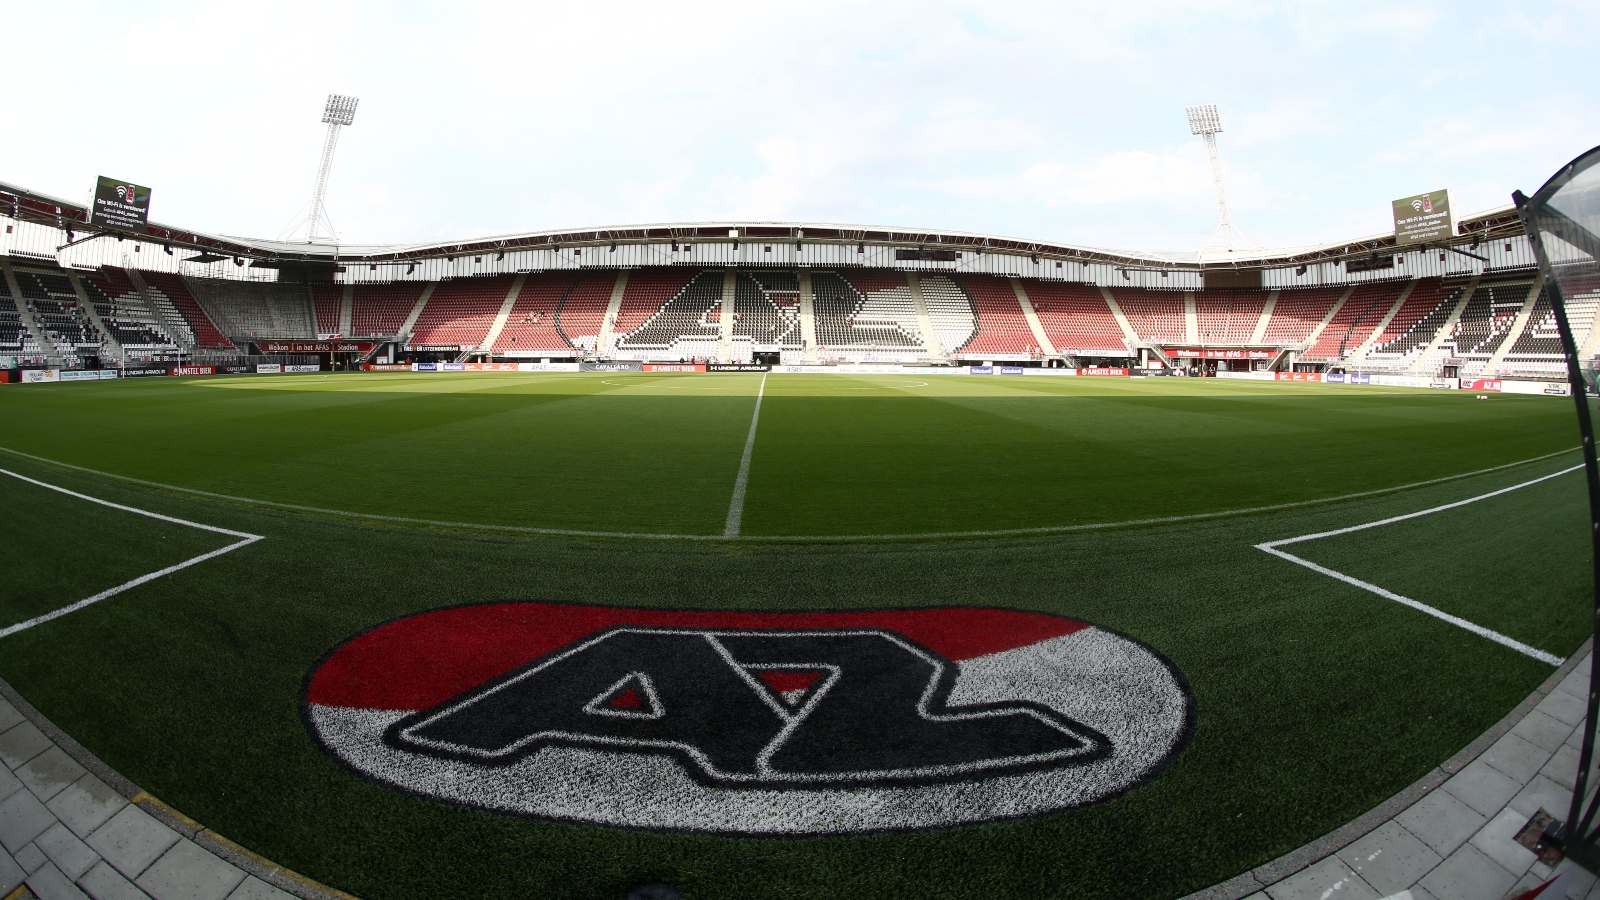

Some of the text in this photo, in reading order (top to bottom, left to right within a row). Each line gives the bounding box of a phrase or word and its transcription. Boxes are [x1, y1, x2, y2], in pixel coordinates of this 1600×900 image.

[106, 200, 118, 208] Wi-Fi
[179, 366, 212, 376] AMSTEL BIER
[1483, 381, 1501, 390] AZ.NL
